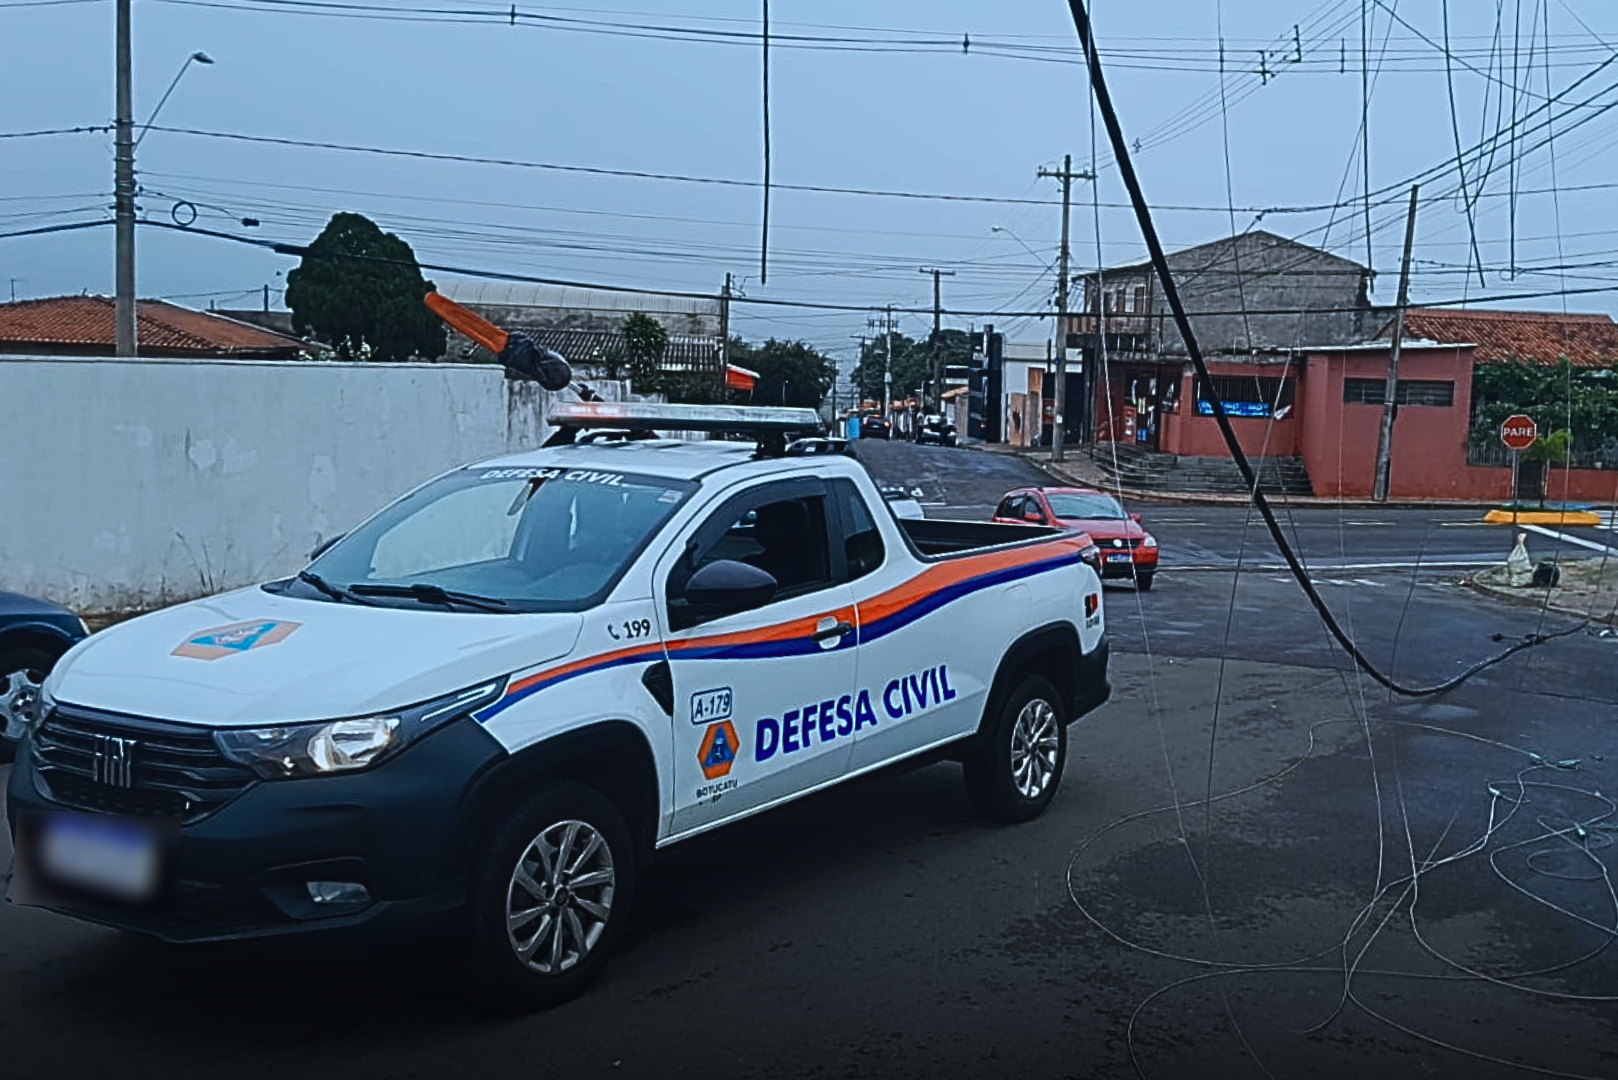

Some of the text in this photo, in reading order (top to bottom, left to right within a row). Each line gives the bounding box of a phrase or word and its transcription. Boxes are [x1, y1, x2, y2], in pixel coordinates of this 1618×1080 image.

[1503, 427, 1534, 437] PARE
[480, 468, 624, 486] DEFESA CIVIL
[623, 619, 651, 639] 199
[695, 692, 730, 719] A-179
[755, 665, 956, 762] DEFESA CIVIL
[696, 779, 738, 798] BOTUCATU
